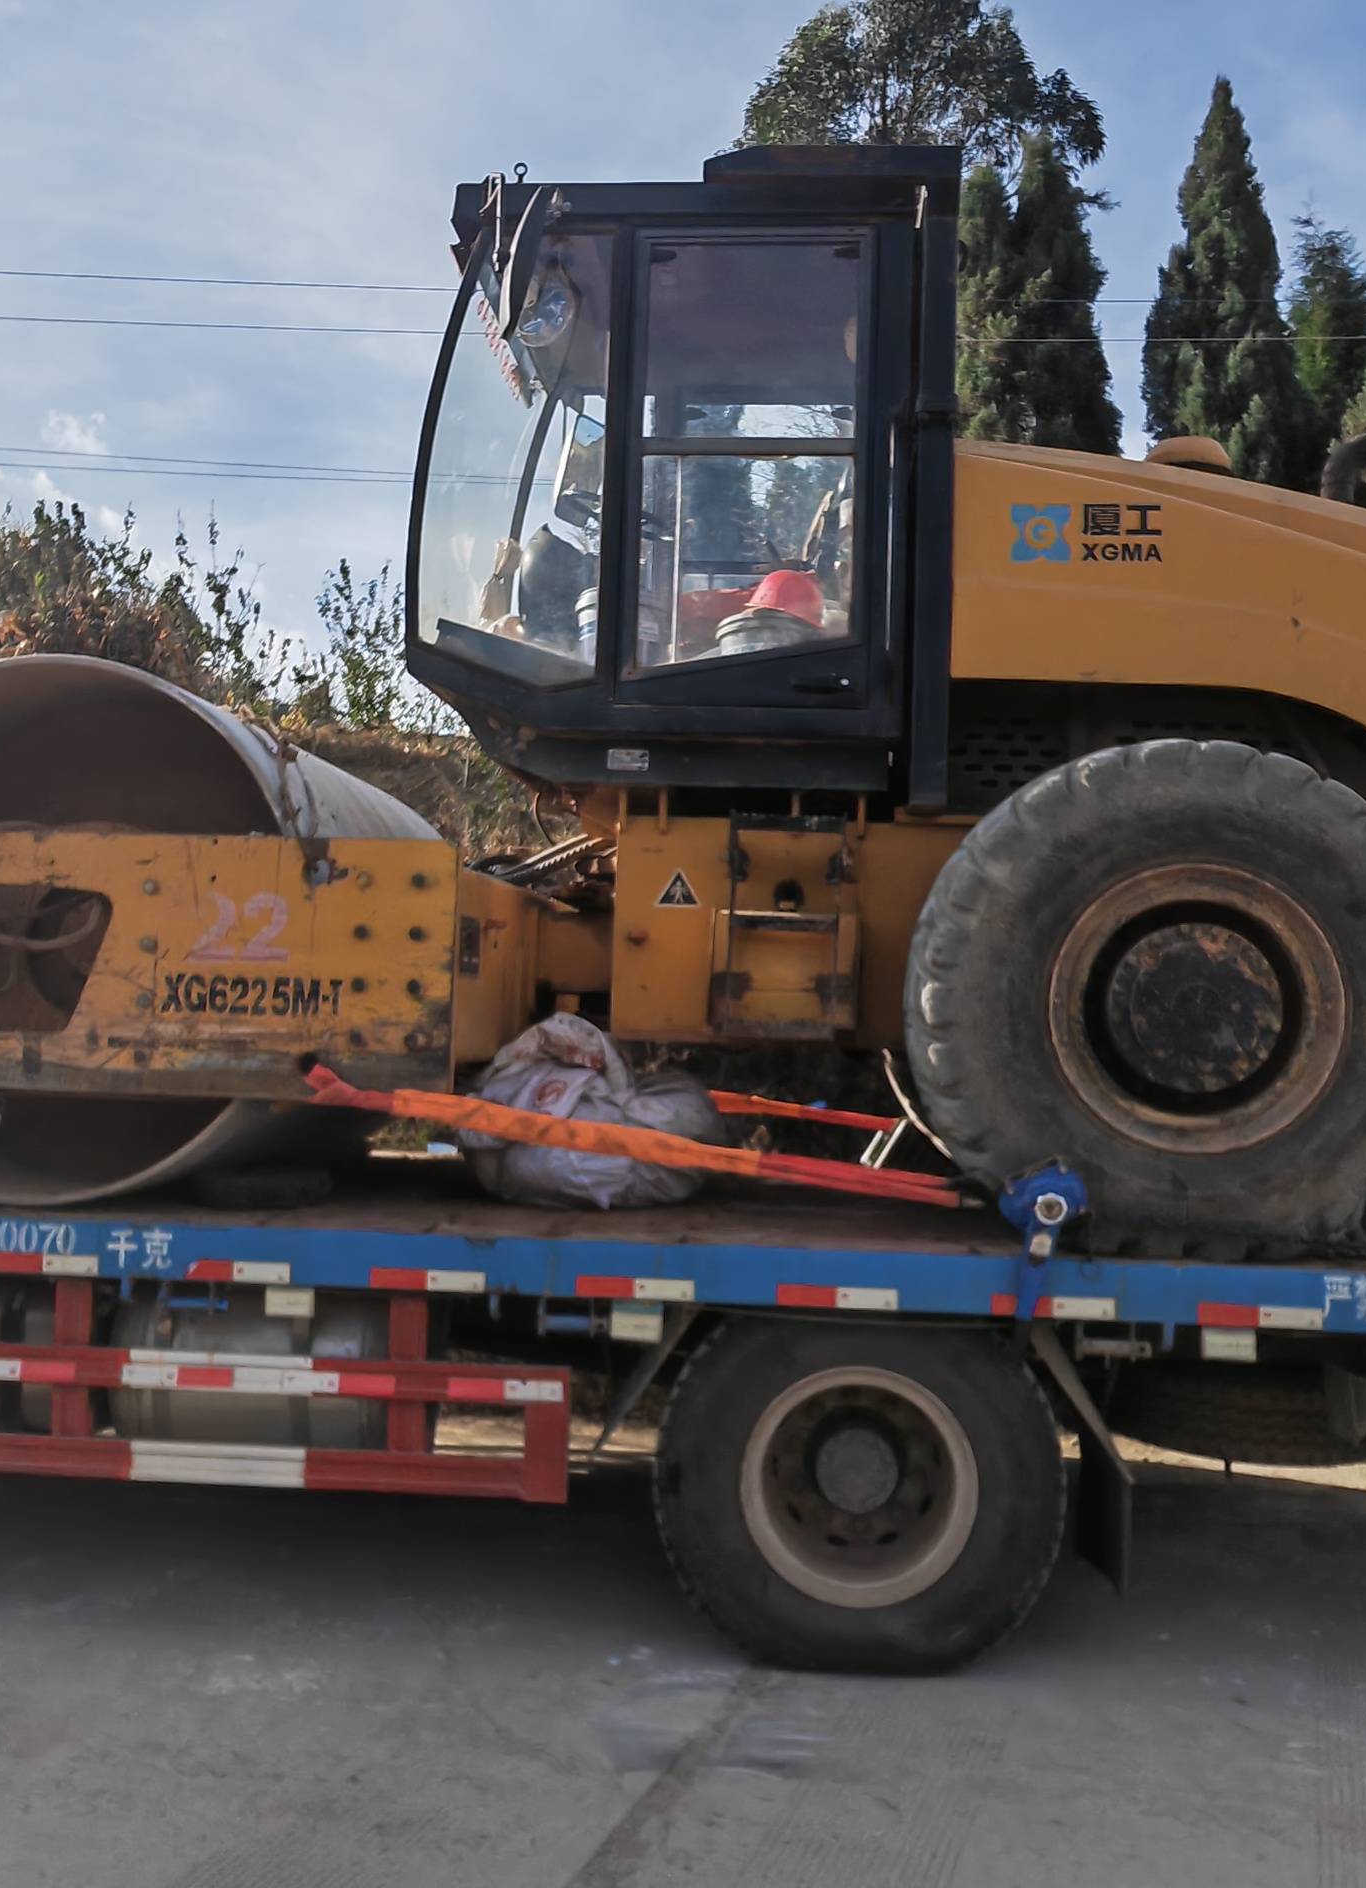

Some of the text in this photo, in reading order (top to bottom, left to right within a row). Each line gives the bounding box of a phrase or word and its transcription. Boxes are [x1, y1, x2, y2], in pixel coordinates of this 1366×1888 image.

[1082, 503, 1163, 536] 厦工
[1081, 543, 1164, 562] XGMA
[186, 890, 291, 964] 22
[160, 972, 344, 1018] XG6225M-T
